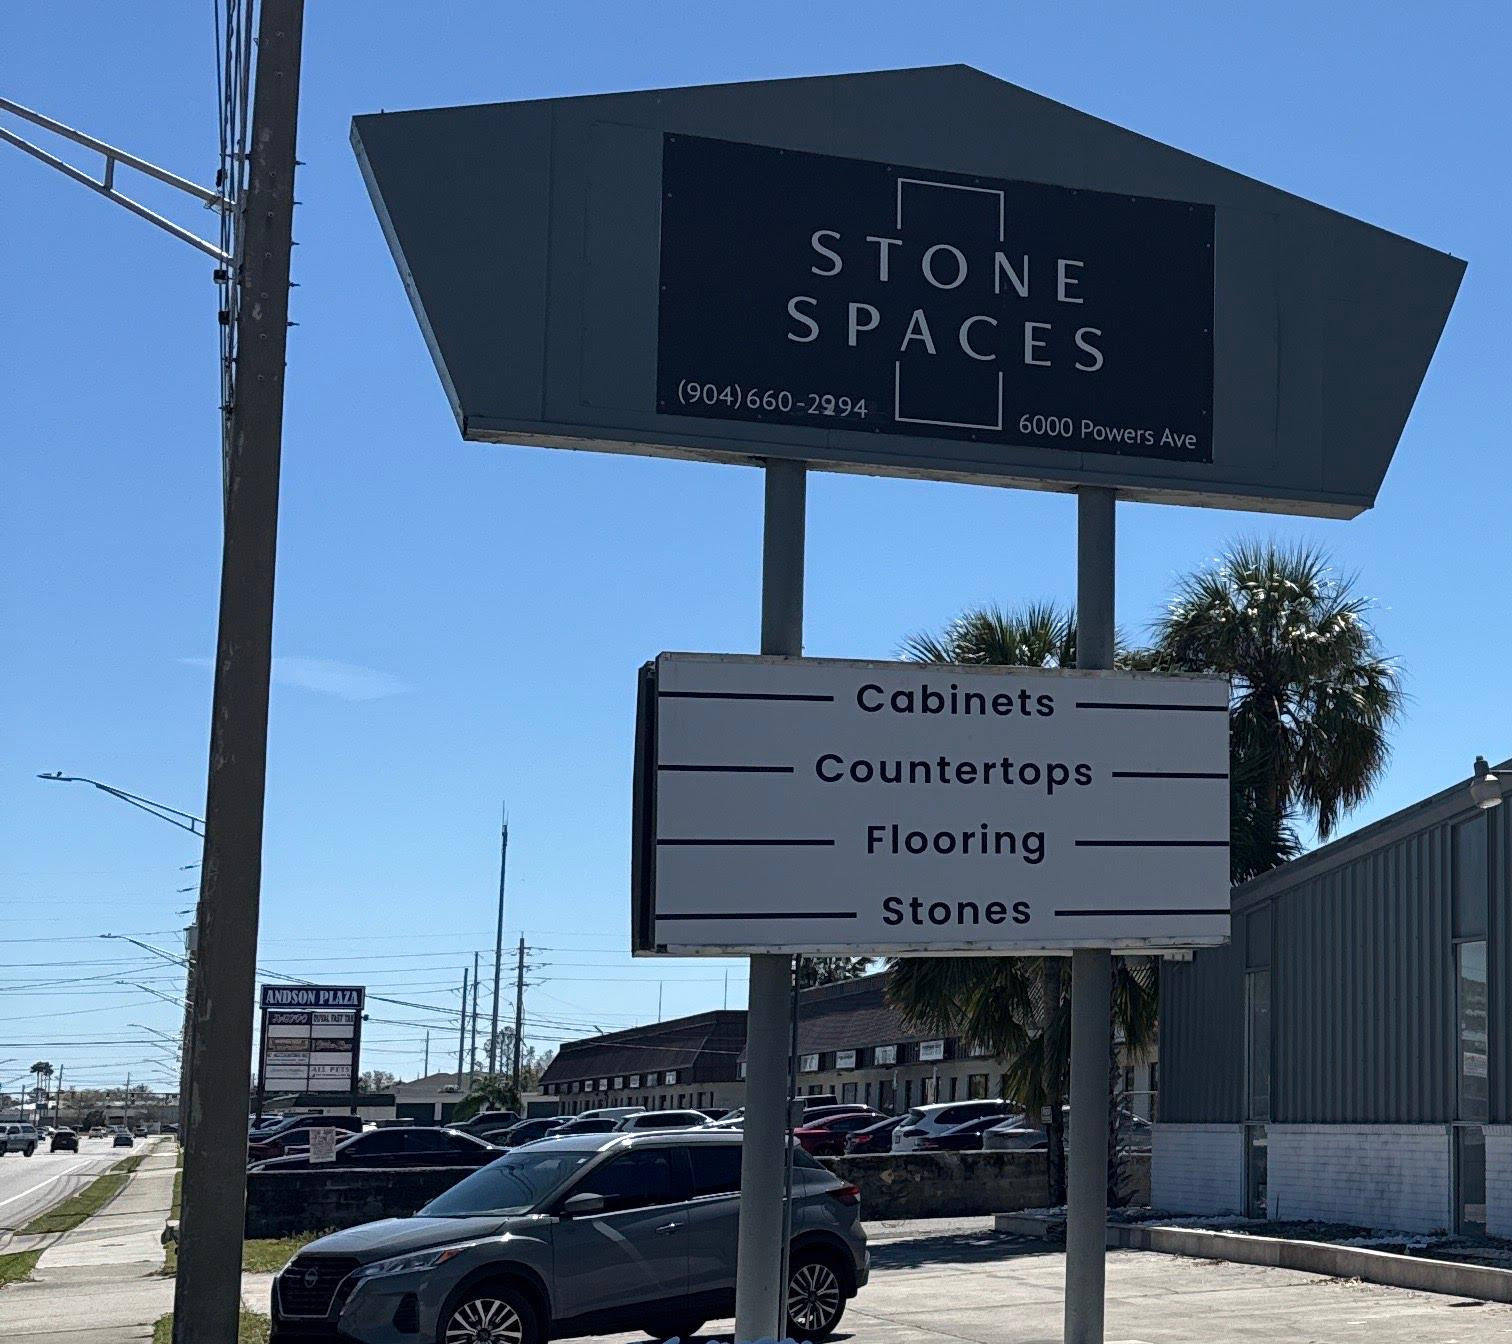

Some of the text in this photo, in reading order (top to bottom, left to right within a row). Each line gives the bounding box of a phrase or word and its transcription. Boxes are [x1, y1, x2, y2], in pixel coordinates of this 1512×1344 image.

[810, 230, 1085, 304] STONE
[787, 296, 1104, 373] SPACES
[1019, 413, 1197, 449] 6000 Powers Ave
[856, 683, 1055, 717] Cabinets
[815, 753, 1093, 795] Countertops
[866, 823, 1046, 865] Flooring
[882, 895, 1031, 926] Stones
[266, 989, 358, 1005] ANDSON PLAZA
